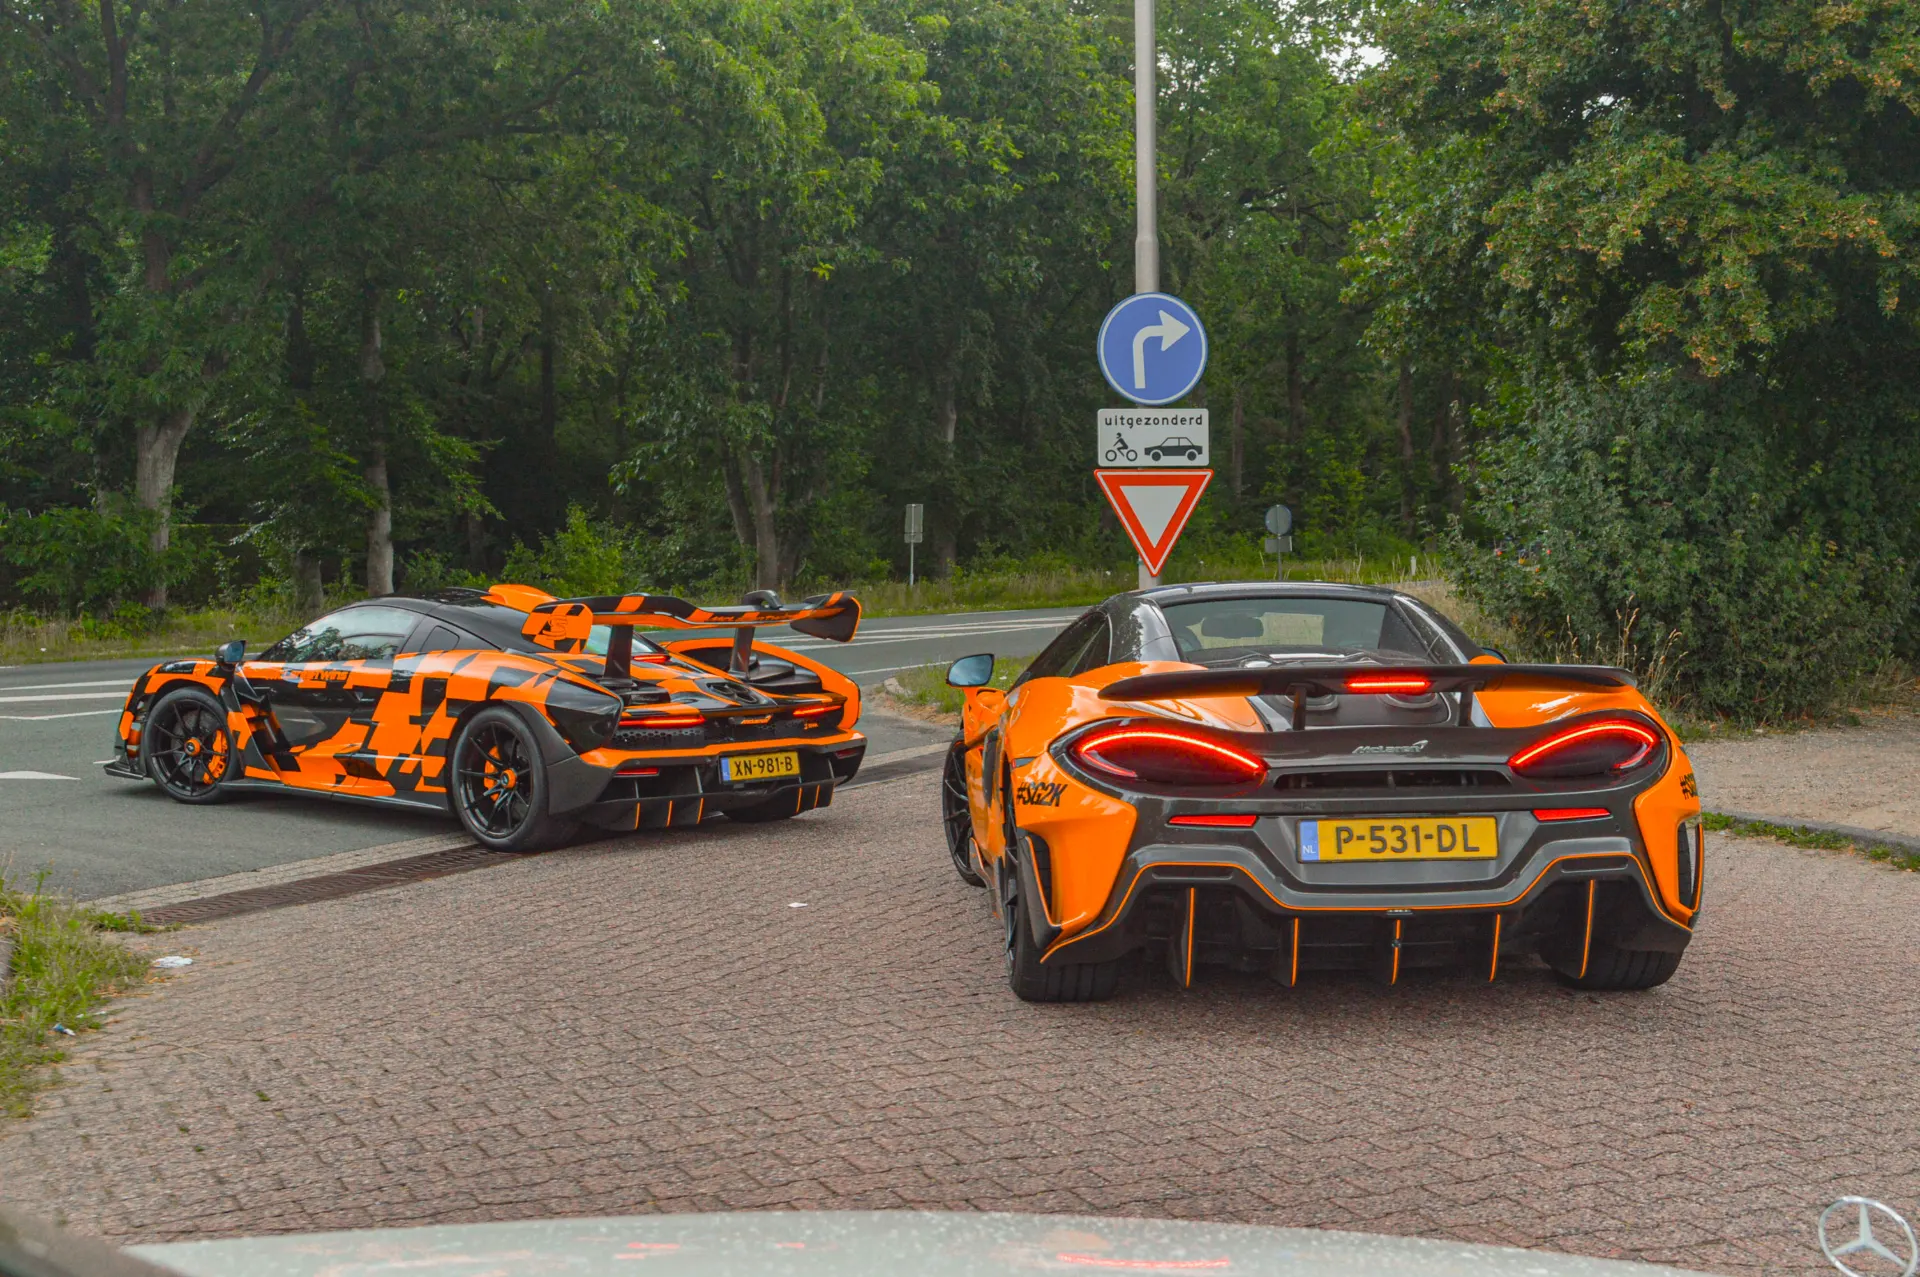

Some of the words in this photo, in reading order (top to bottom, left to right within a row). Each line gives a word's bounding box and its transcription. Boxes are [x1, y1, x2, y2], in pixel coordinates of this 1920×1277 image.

[1104, 414, 1203, 429] uitgezonderd
[734, 756, 794, 777] XN-981-B
[1302, 844, 1316, 854] NL
[1335, 824, 1480, 854] P-531-DL
